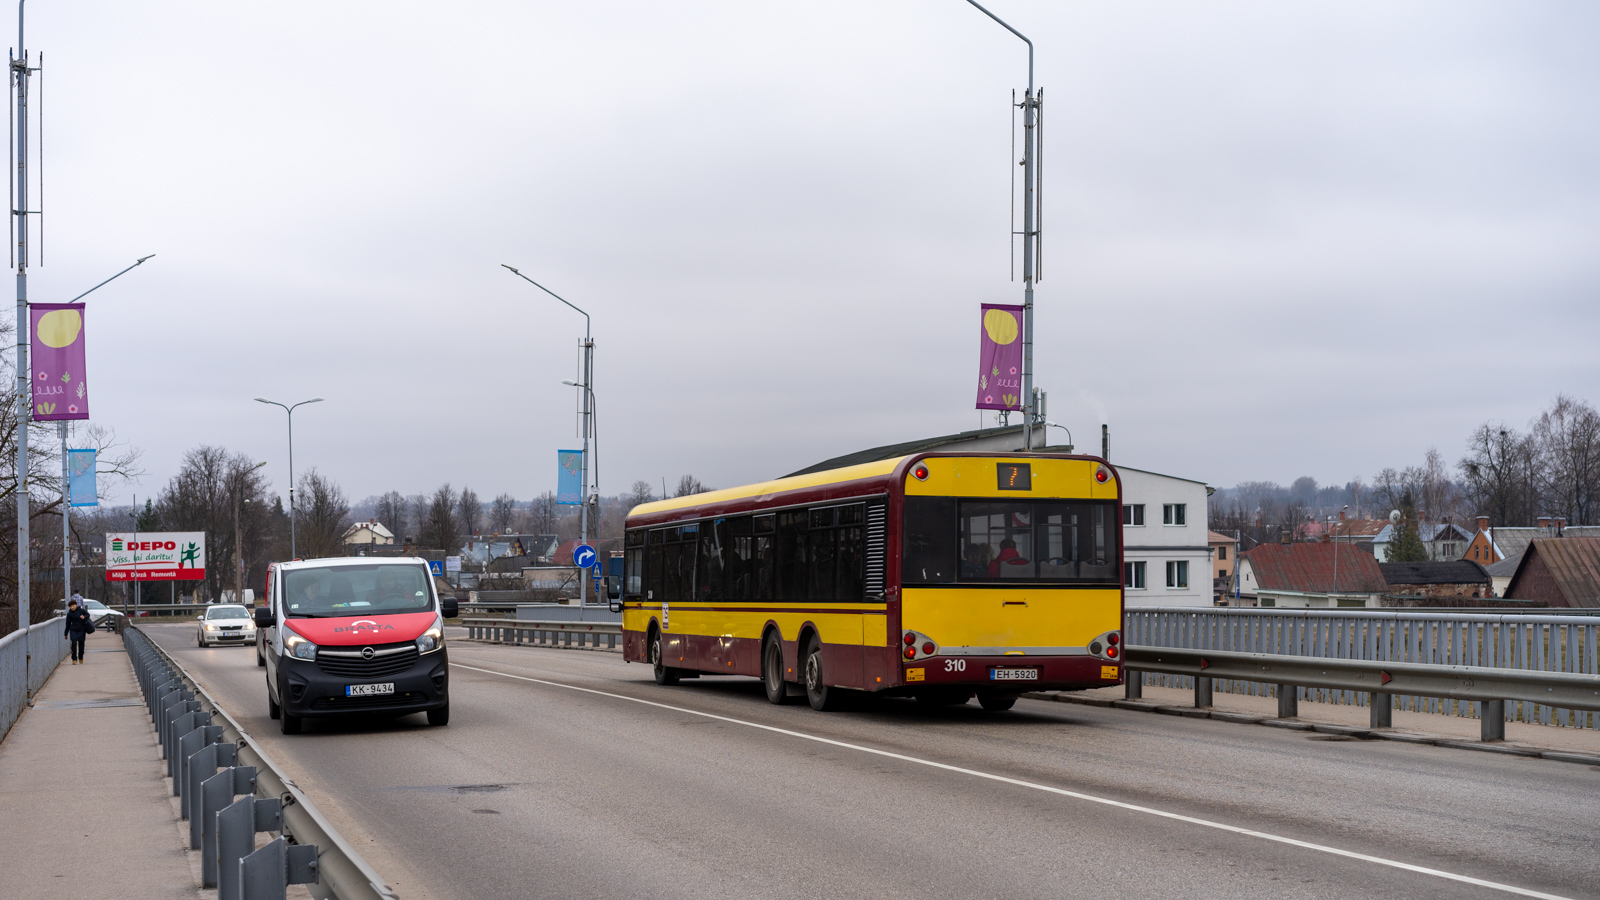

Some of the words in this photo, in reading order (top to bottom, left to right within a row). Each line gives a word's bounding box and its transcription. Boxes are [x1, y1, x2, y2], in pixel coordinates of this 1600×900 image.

[1009, 467, 1017, 486] 7
[127, 541, 176, 551] DEPO
[133, 553, 143, 561] lai
[334, 624, 395, 633] BRASTA
[944, 659, 966, 672] 310
[996, 670, 1037, 679] EH-5920
[352, 684, 393, 695] KK-9434
